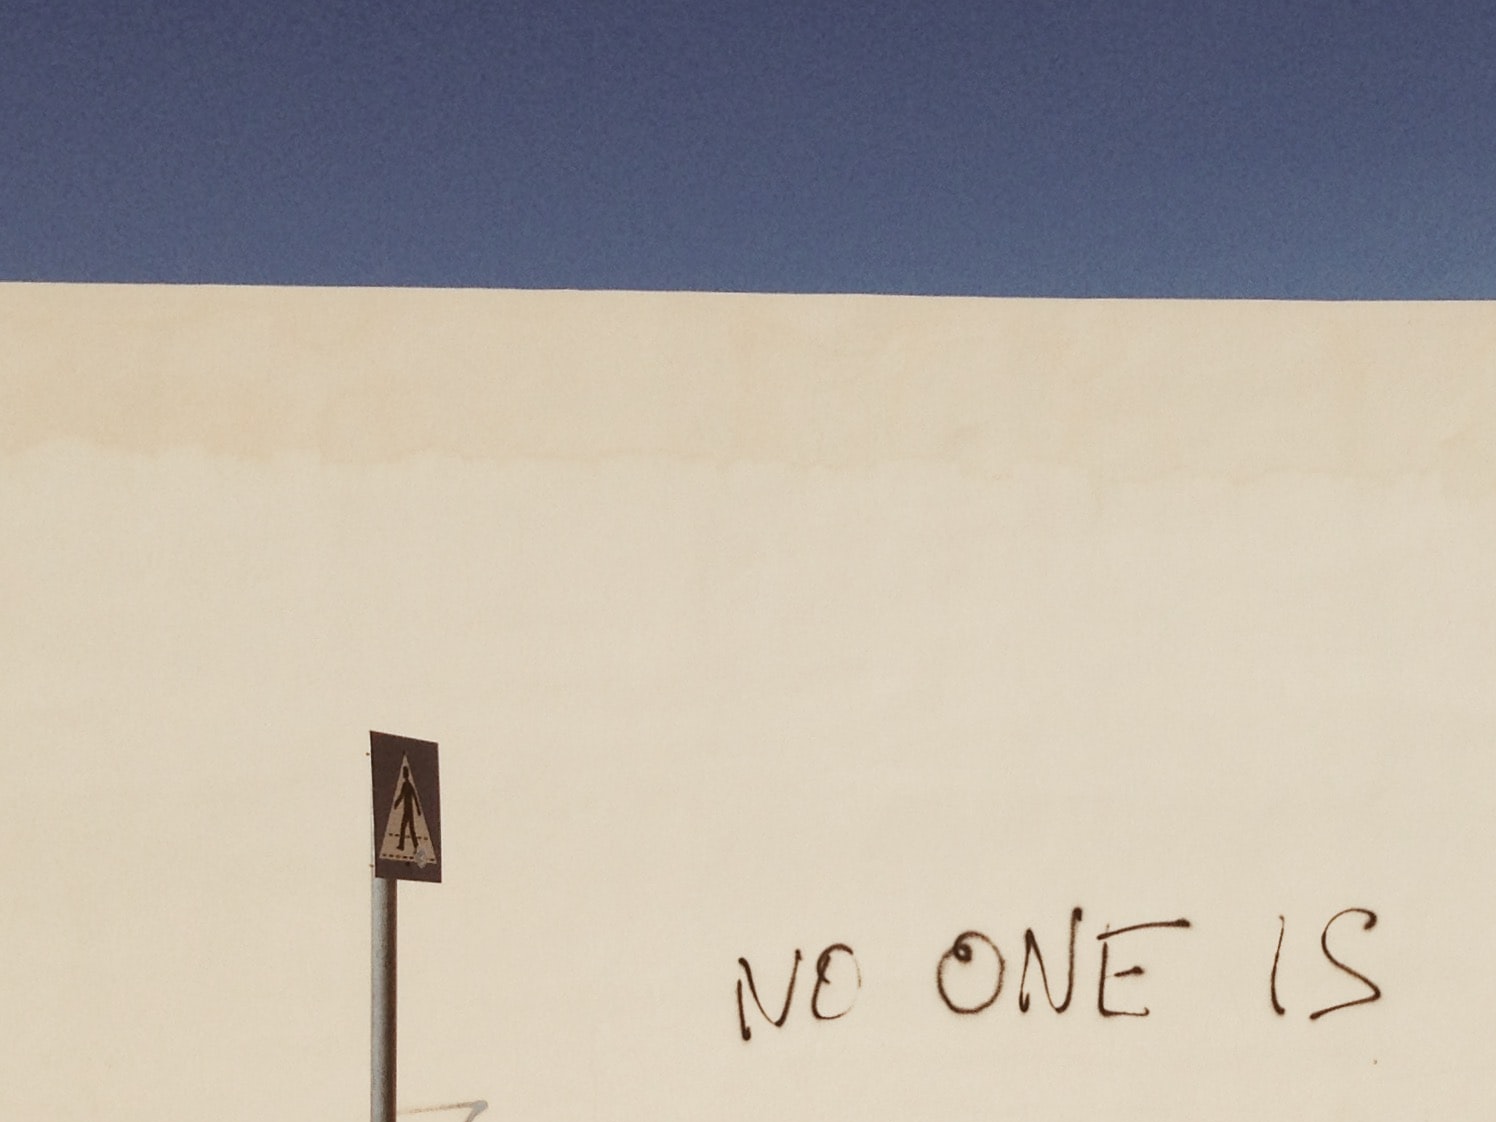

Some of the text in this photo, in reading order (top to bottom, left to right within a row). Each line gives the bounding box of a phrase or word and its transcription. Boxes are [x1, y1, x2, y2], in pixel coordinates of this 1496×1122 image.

[734, 942, 862, 1043] NO
[935, 905, 1193, 1019] ONE
[1269, 907, 1384, 1022] IS
